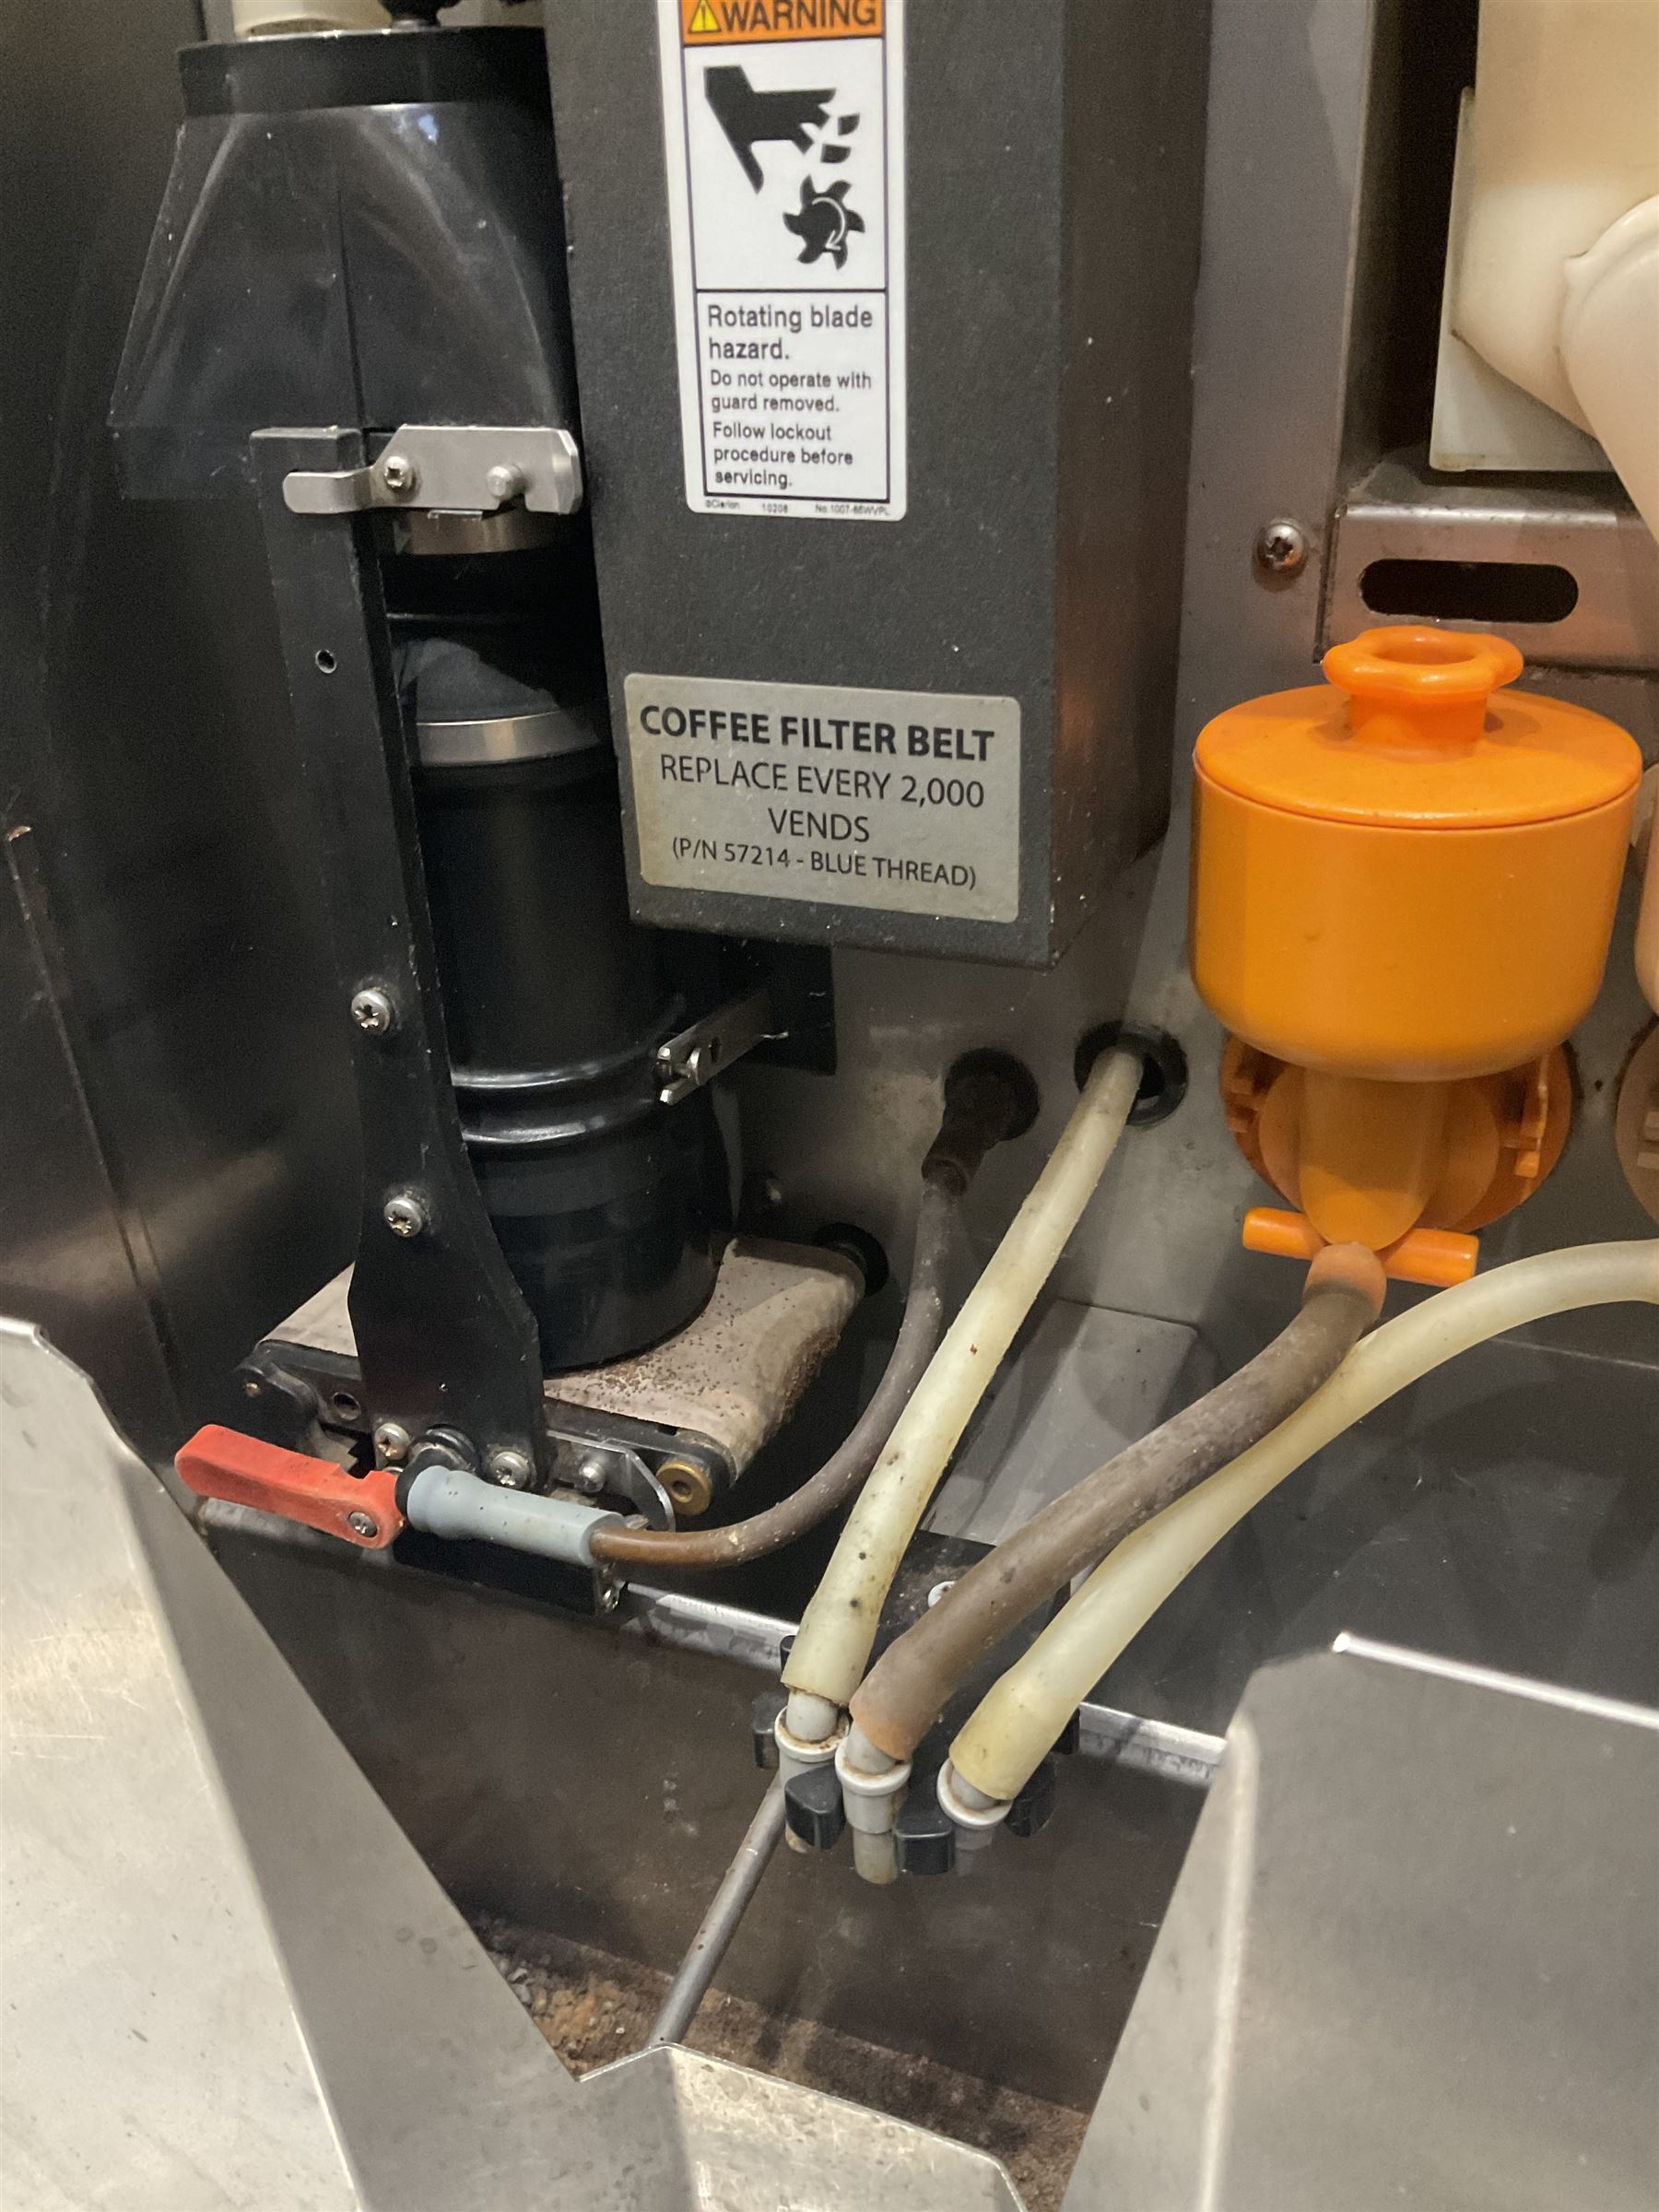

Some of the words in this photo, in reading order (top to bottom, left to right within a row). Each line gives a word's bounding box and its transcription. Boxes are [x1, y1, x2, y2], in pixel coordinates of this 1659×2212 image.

[722, 0, 876, 31] WARNING
[707, 304, 802, 333] Rotating
[810, 305, 873, 327] blade
[709, 336, 790, 359] hazard.
[711, 370, 732, 387] Do
[737, 371, 763, 387] not
[769, 372, 830, 390] operate
[837, 371, 872, 389] with
[712, 394, 758, 413] guard
[763, 395, 841, 412] removed.
[712, 422, 765, 439] Follow
[771, 423, 832, 441] lockout
[713, 447, 795, 465] procedure
[801, 448, 853, 465] before
[715, 469, 793, 489] servicing.
[641, 705, 771, 745] COFFEE
[781, 716, 897, 755] FILTER
[908, 724, 995, 761] BELT
[661, 754, 788, 791] REPLACE
[798, 765, 891, 800] EVERY
[900, 774, 984, 808] 2,000
[768, 807, 870, 842] VENDS
[673, 837, 717, 860] (P/N
[724, 842, 791, 867] 57214
[811, 851, 867, 876] BLUE
[872, 856, 977, 890] THREAD)
